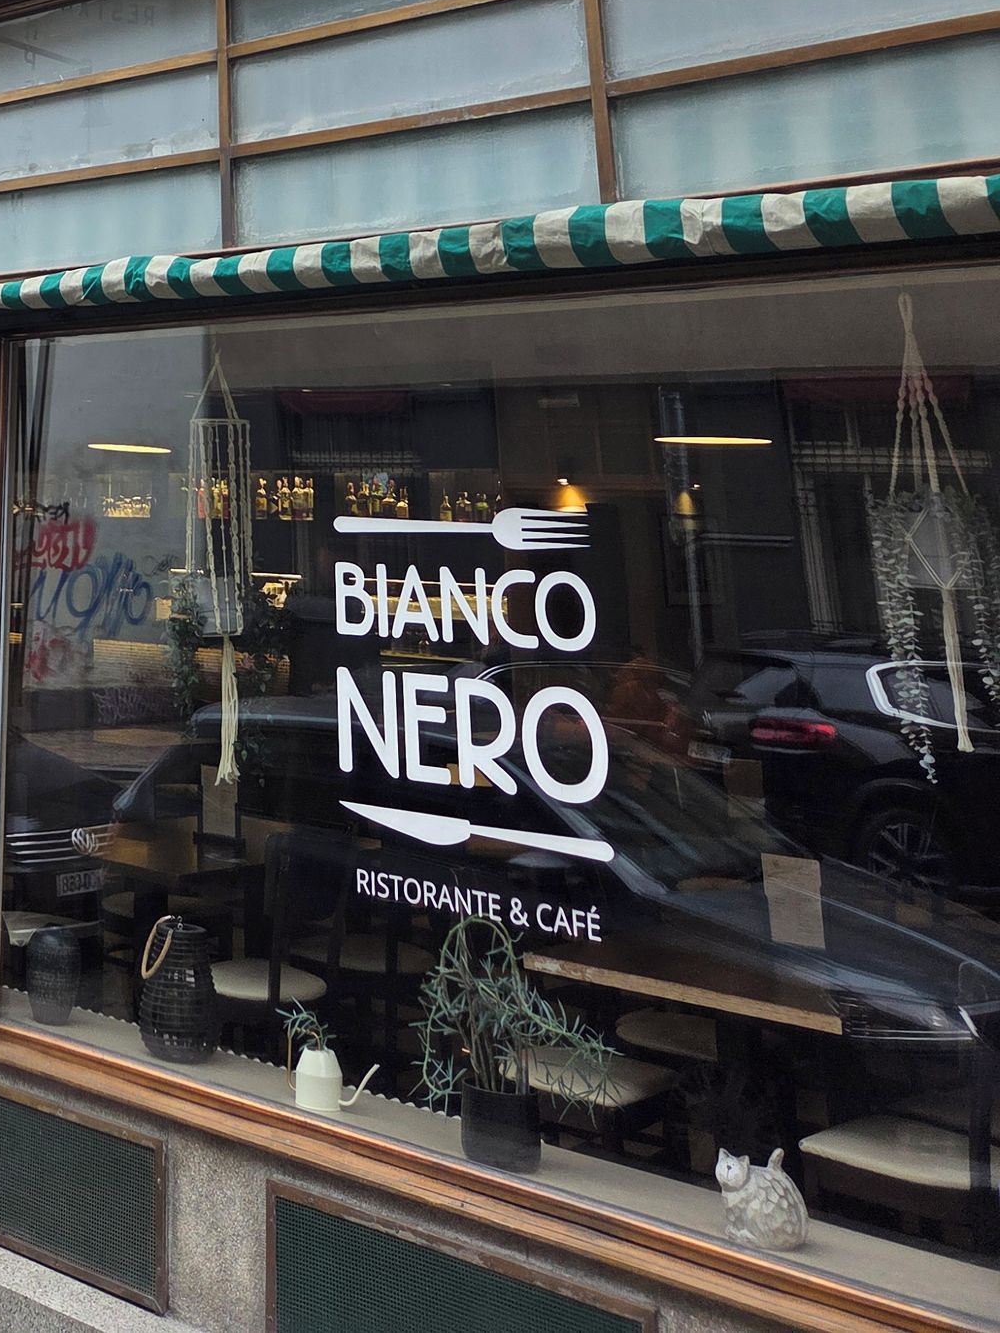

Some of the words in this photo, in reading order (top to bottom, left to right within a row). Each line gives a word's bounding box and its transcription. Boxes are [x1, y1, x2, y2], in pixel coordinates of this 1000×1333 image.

[334, 561, 597, 652] BIANCO
[336, 666, 609, 804] NERO
[356, 868, 502, 922] RISTORANTE
[509, 897, 529, 927] &
[535, 903, 603, 942] CAFÉ
